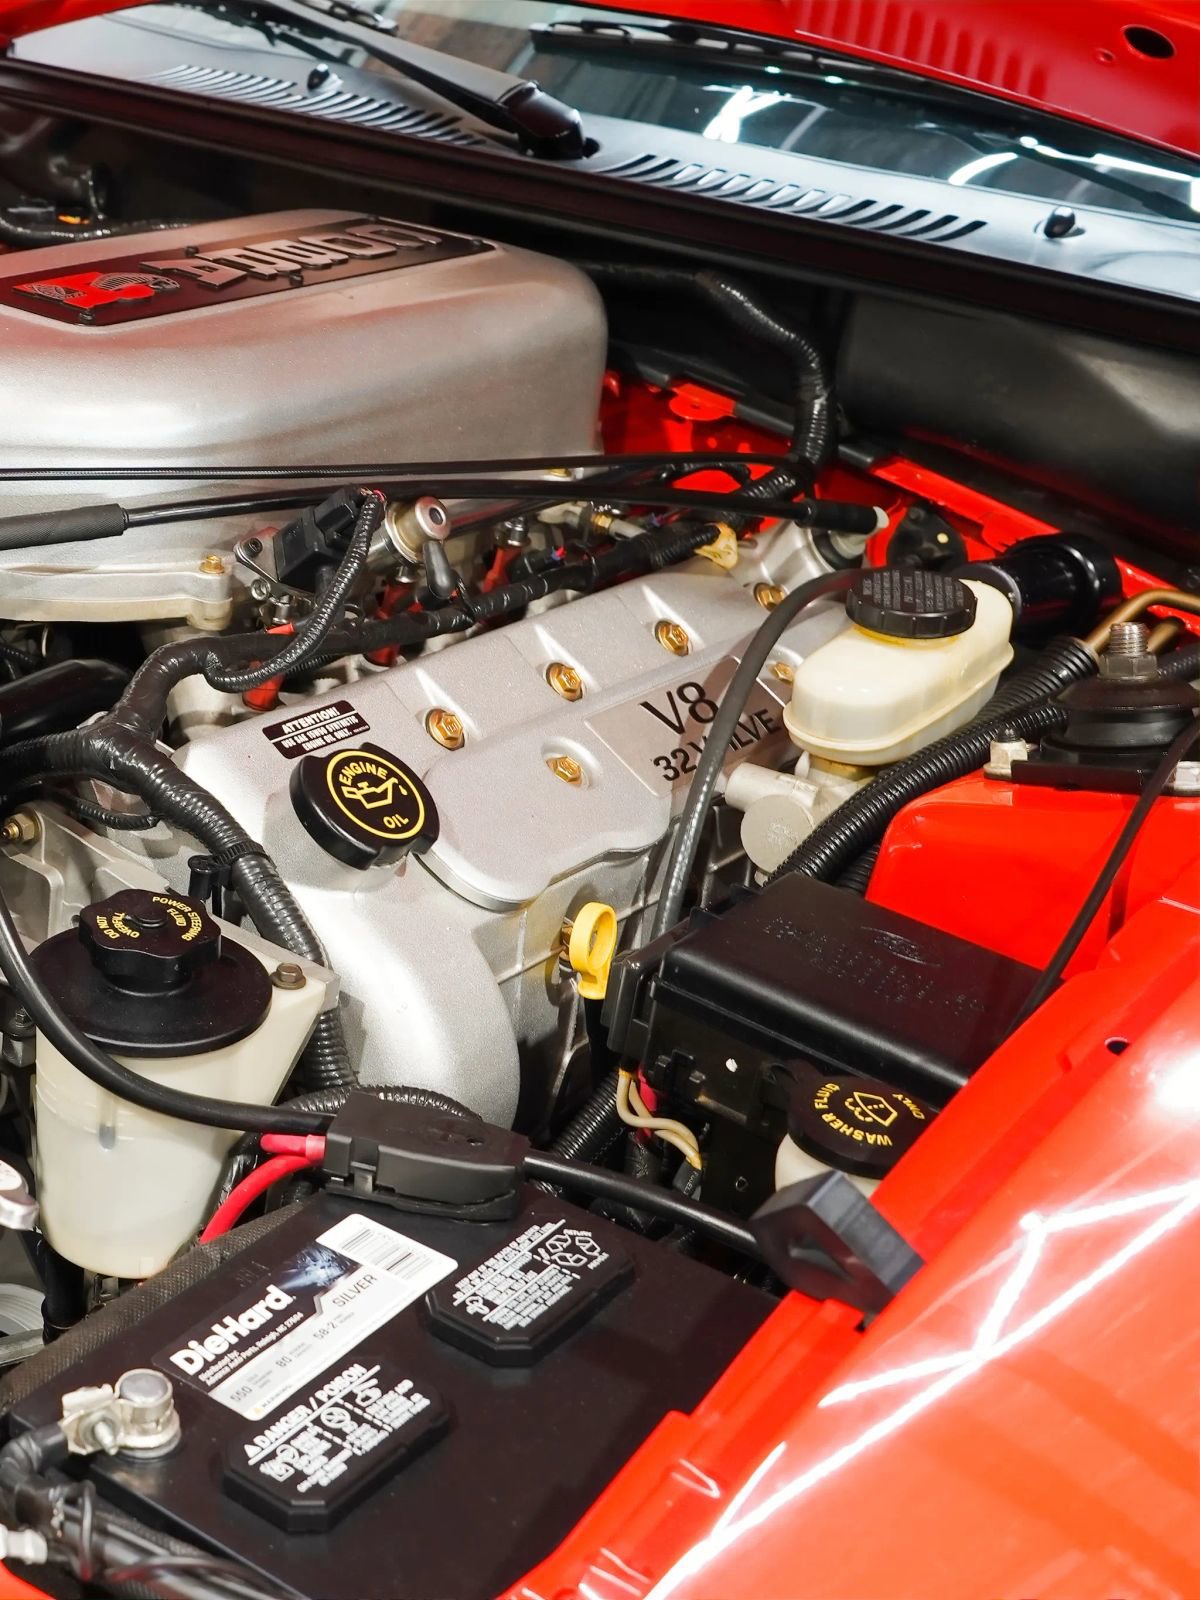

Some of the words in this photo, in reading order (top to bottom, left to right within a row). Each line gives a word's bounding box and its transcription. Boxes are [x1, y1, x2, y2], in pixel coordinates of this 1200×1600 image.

[281, 706, 341, 734] ATTENTION!
[639, 681, 720, 736] V8
[281, 738, 297, 749] USE
[294, 734, 308, 744] SAE
[326, 715, 359, 732] SYNTHETIC
[302, 739, 326, 752] ENGINE
[324, 735, 337, 744] OIL
[333, 727, 353, 740] ONLY.
[653, 748, 698, 782] 32
[687, 708, 782, 755] LVE
[338, 761, 388, 786] ENGINE
[383, 813, 410, 829] OIL
[96, 915, 109, 930] NOT
[111, 912, 140, 939] OVERFILL
[152, 896, 192, 913] POWER
[181, 911, 203, 941] STEERING
[166, 907, 187, 927] FLUID
[103, 928, 120, 939] DO
[814, 1083, 840, 1110] FLUID
[891, 1092, 926, 1120] ONLY
[821, 1112, 893, 1147] WASHER
[332, 1274, 379, 1308] SILVER
[169, 1284, 295, 1376] DieHard
[253, 1404, 313, 1449] DANGER
[314, 1363, 368, 1402] POISON
